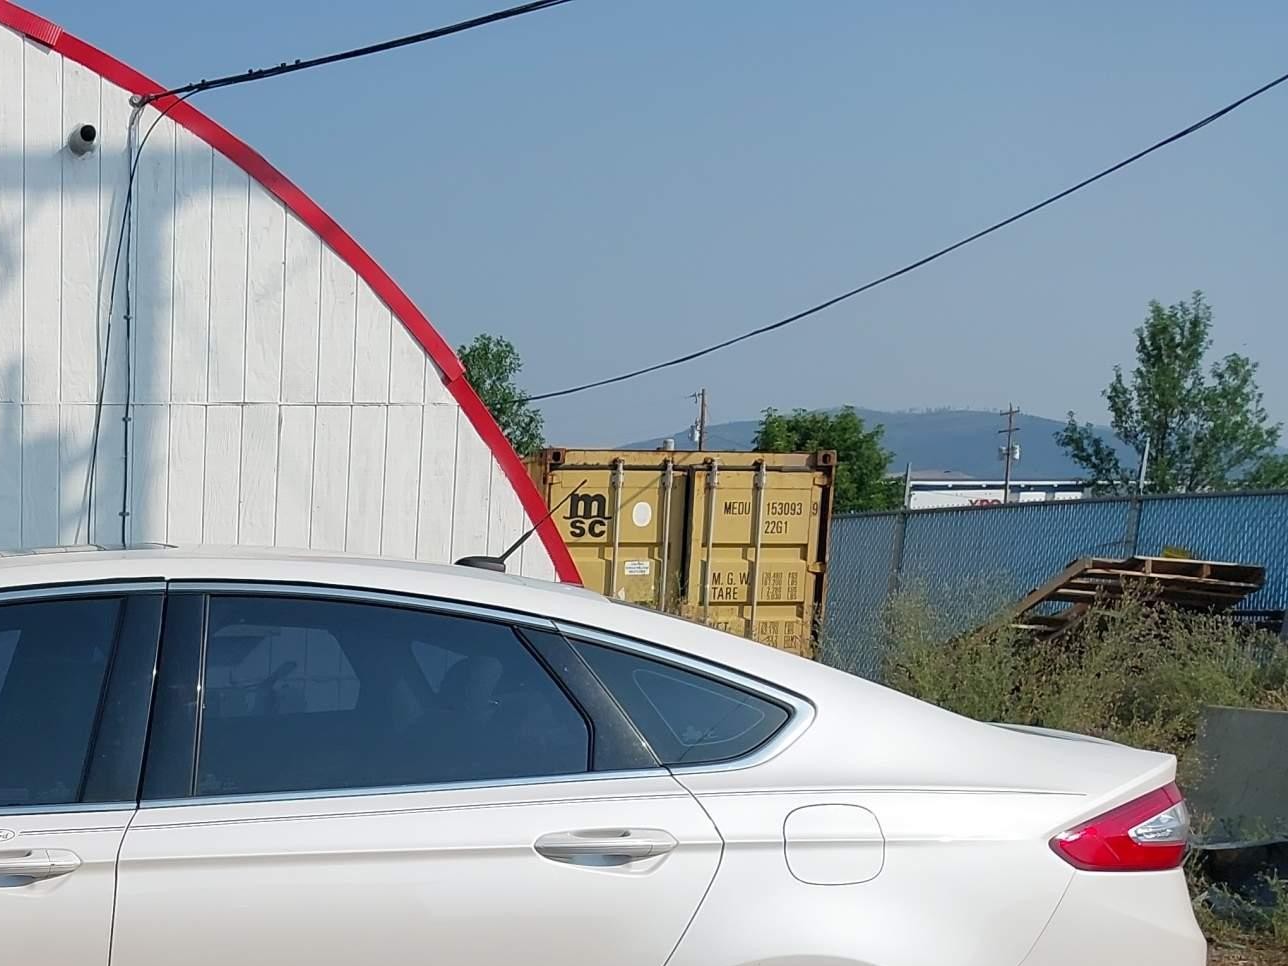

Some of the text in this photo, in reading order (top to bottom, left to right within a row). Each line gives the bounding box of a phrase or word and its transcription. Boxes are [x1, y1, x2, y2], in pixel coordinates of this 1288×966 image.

[724, 501, 819, 515] MEDU 153093 9
[764, 520, 788, 534] 22G1
[712, 587, 738, 600] TARE
